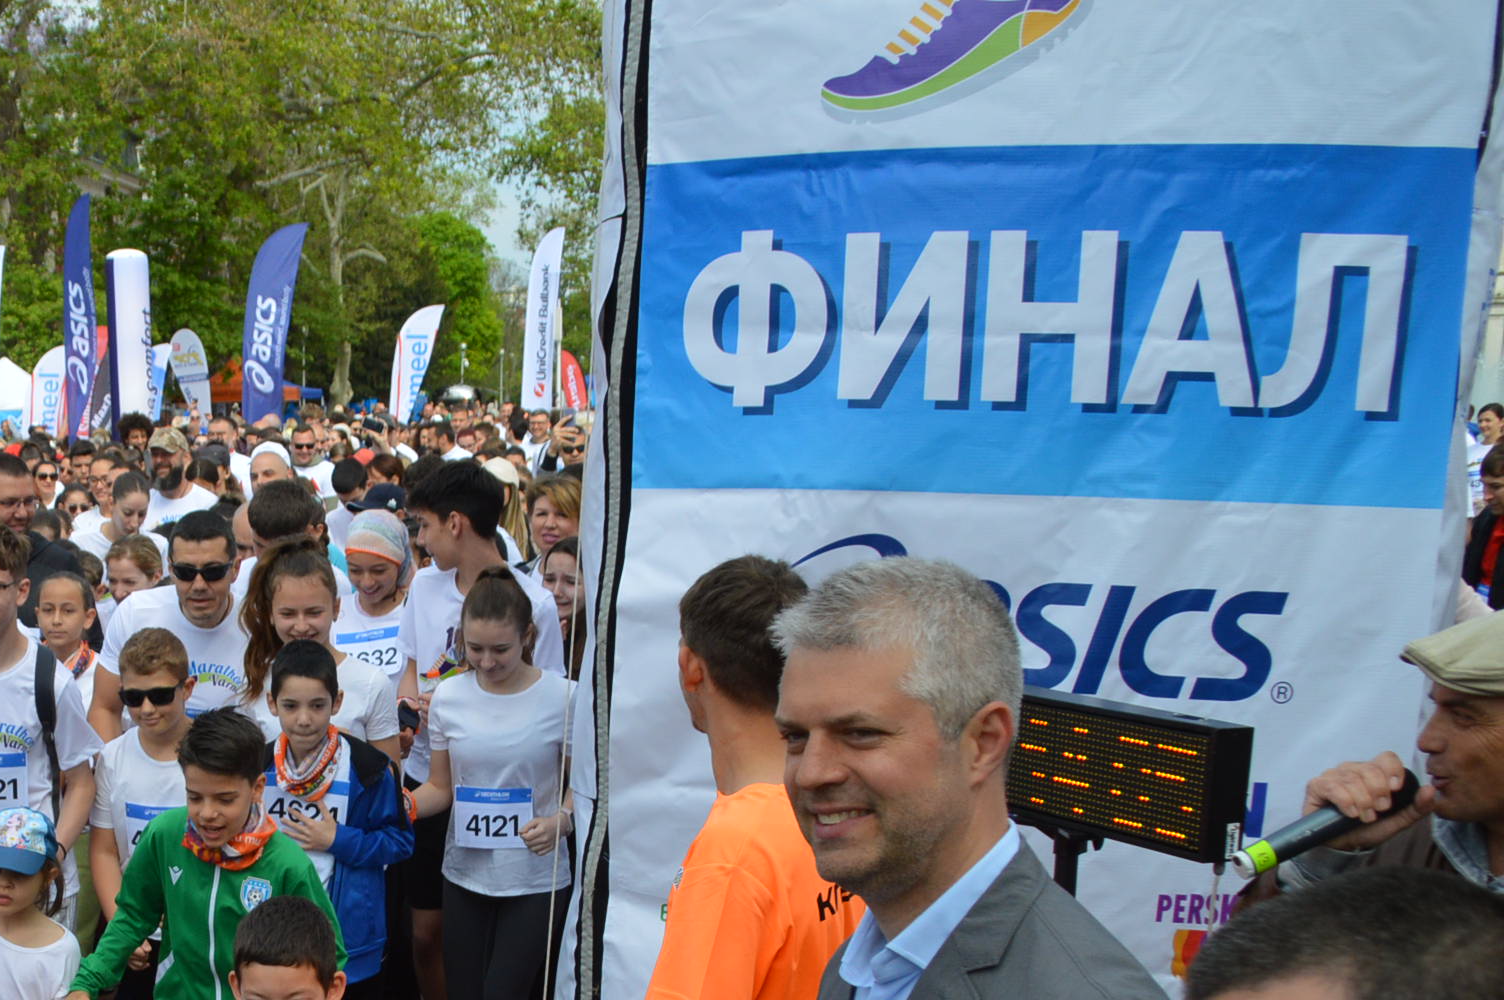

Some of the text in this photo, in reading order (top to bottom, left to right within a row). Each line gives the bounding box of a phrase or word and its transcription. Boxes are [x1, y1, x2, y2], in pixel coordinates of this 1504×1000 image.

[682, 228, 1410, 413] ФИНАЛ
[981, 579, 1290, 702] SICS
[465, 814, 520, 838] 4121
[1155, 893, 1240, 926] PERSK
